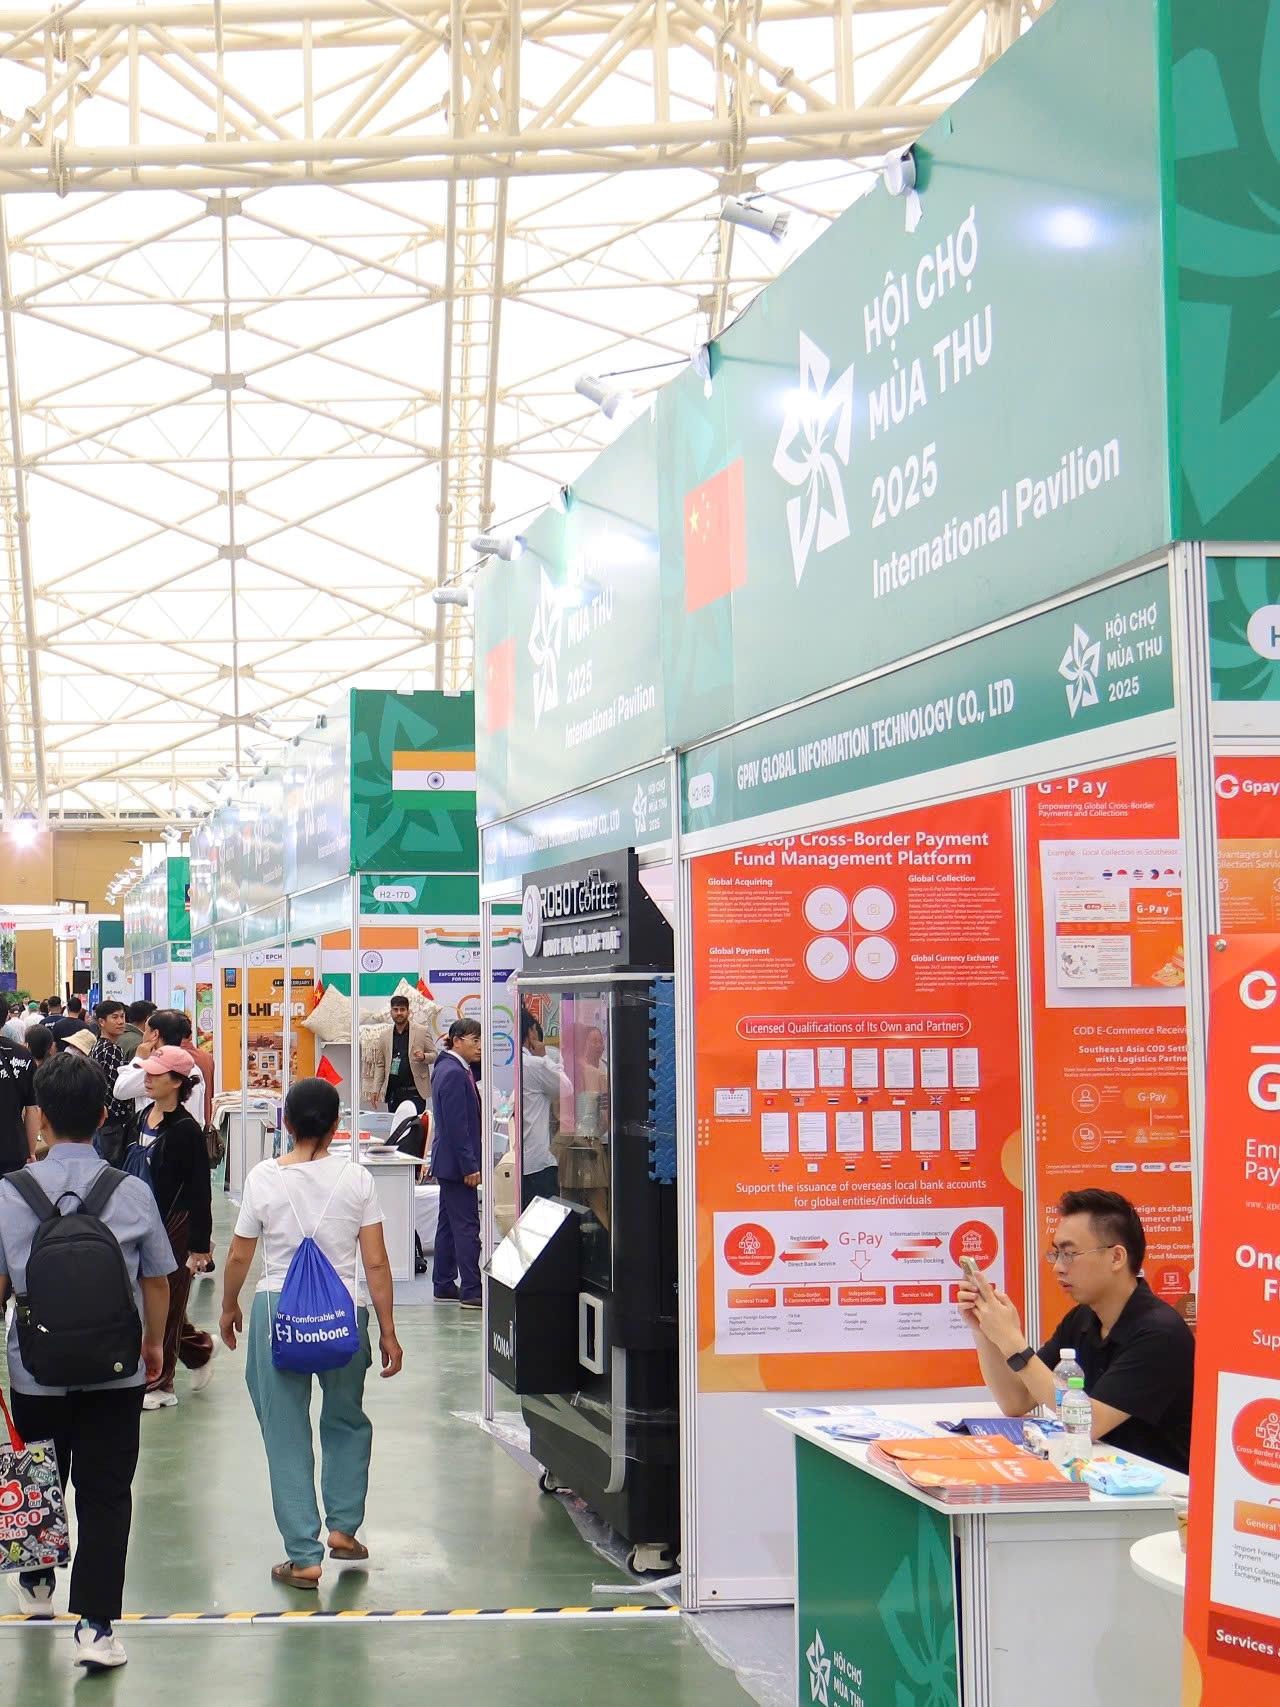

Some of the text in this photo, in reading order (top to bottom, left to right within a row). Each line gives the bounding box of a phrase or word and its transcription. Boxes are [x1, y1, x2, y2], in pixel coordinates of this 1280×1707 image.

[863, 204, 978, 355] HỘI CHỢ
[868, 303, 993, 441] MÙA THU
[871, 441, 938, 529] 2025
[873, 437, 1120, 599] International Pavilion
[591, 587, 614, 630] THU
[1105, 601, 1158, 643] HỘI CHỢ
[1106, 635, 1163, 672] MÙA THU
[566, 659, 593, 705] 2025
[1108, 675, 1140, 702] 2025
[565, 683, 656, 749] International Pavilion
[737, 677, 1015, 791] GPAY GLOBAL INFORMATION TECHNOLOGY CO., LTD
[1038, 810, 1073, 818] Payments
[1089, 809, 1129, 817] Collections
[1084, 802, 1107, 810] Global
[1108, 802, 1156, 810] Cross-Border
[800, 831, 989, 850] Cross-Border Payment
[733, 850, 972, 870] Fund Management Platform
[707, 878, 774, 888] Global Acquiring
[907, 874, 976, 883] Global Collection
[379, 891, 410, 899] H2-17D
[1136, 904, 1169, 916] G-Pay
[709, 947, 770, 957] Global Payment
[910, 954, 1000, 964] Global Currency Exchange
[744, 1020, 964, 1034] Licensed Qualifications of Its Own and Partners
[1073, 1026, 1155, 1036] COD E-Commerce
[1078, 1044, 1166, 1053] Southeast Asia COD
[1095, 1055, 1157, 1065] with Logistics
[1137, 1092, 1167, 1104] G-Pay
[735, 1179, 987, 1195] Support the issuance of overseas local bank accounts
[793, 1195, 933, 1209] for global entities/individuals
[789, 1234, 821, 1242] Registration
[838, 1231, 883, 1248] G-Pay
[291, 1312, 335, 1324] comfortable
[295, 1325, 350, 1343] bonbone
[1245, 1517, 1277, 1532] General
[39, 1529, 66, 1547] PEPCO
[1233, 1550, 1262, 1563] Payment
[1233, 1562, 1253, 1574] Export
[1233, 1569, 1262, 1583] Exchange
[1215, 1628, 1274, 1656] Services
[833, 1650, 862, 1690] HỘI CHỢ
[833, 1673, 849, 1702] MÙA
